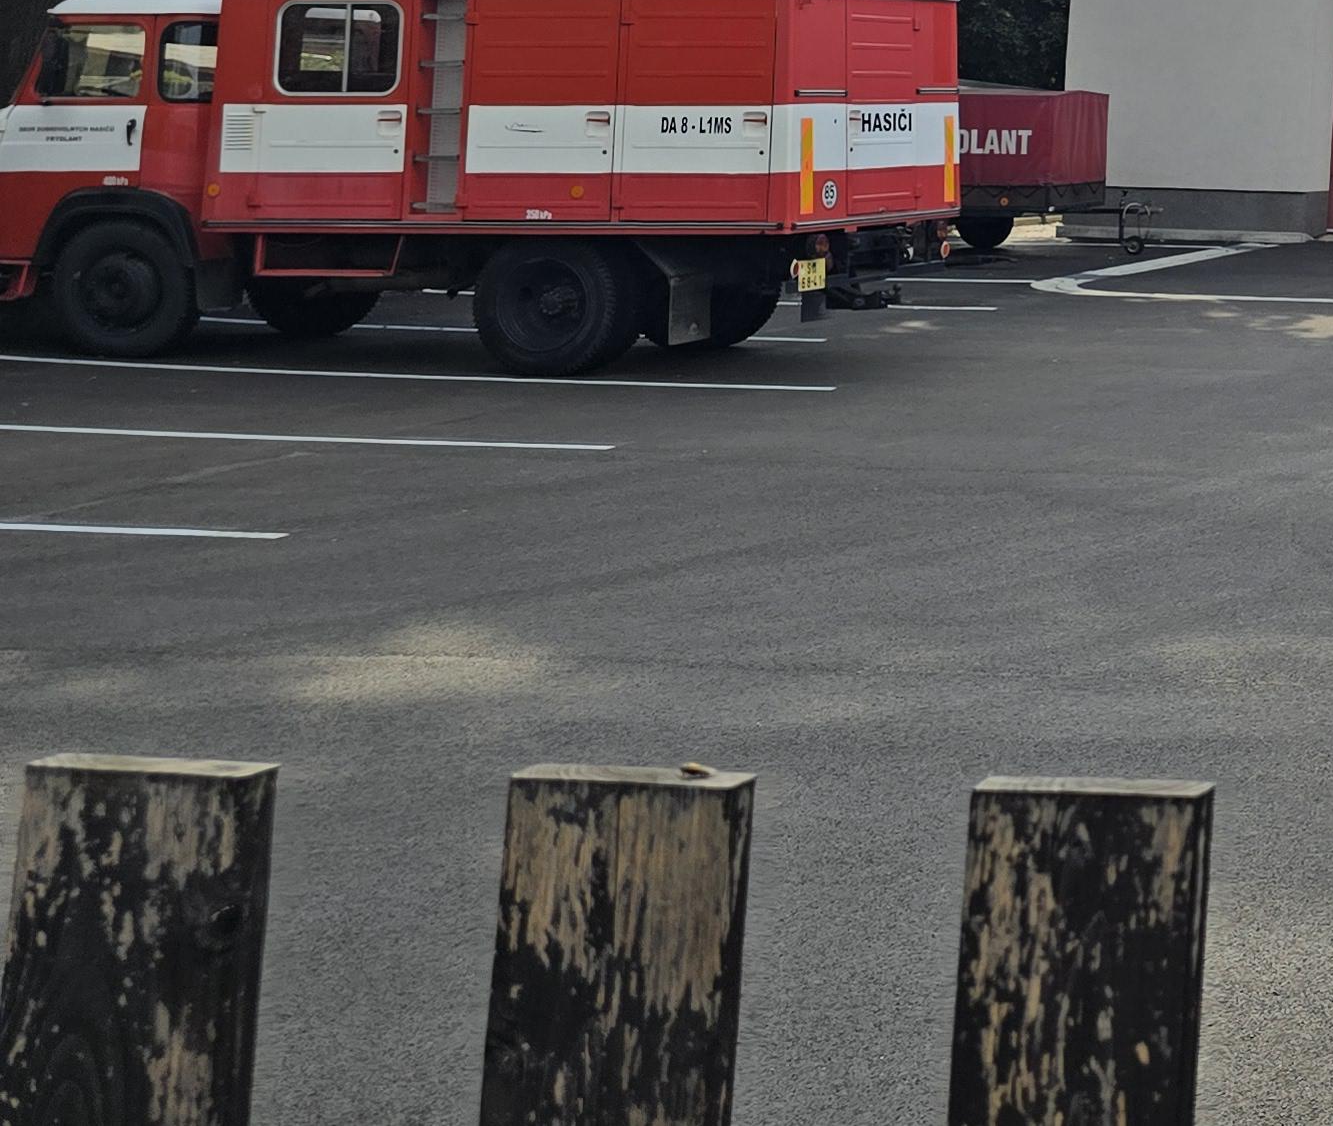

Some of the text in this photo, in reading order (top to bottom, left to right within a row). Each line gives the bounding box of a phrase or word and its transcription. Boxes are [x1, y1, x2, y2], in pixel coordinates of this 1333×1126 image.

[661, 117, 677, 134] DA
[681, 117, 688, 134] 8
[699, 117, 732, 134] L1MS
[861, 109, 912, 132] HASIČI
[824, 184, 835, 199] 85
